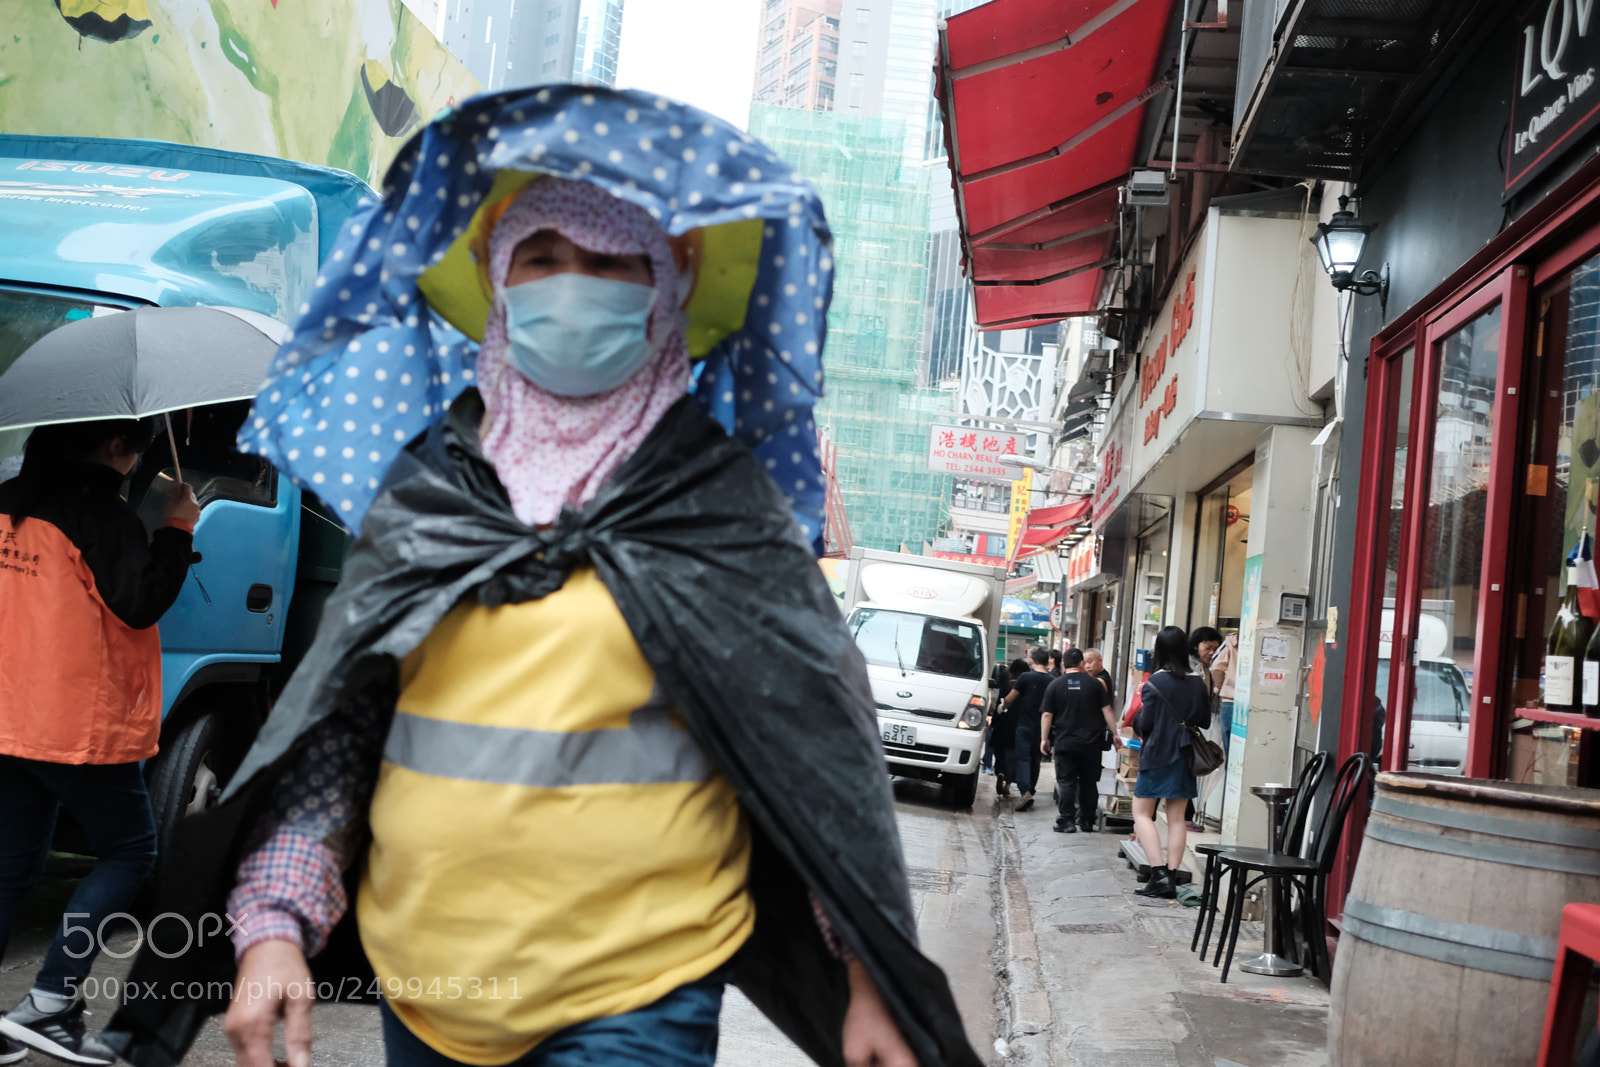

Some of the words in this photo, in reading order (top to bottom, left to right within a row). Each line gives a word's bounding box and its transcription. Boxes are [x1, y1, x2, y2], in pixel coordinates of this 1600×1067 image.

[1514, 131, 1529, 154] Le
[1567, 68, 1595, 103] Vins
[16, 161, 191, 182] ISUZU
[933, 449, 945, 458] HO
[947, 450, 973, 461] CHARN
[975, 453, 993, 463] REAL
[945, 462, 962, 471] TEL:
[964, 464, 984, 473] 2544
[987, 466, 1006, 476] 3955
[911, 588, 932, 598] KIA
[892, 724, 908, 735] SF
[882, 731, 914, 745] 6415
